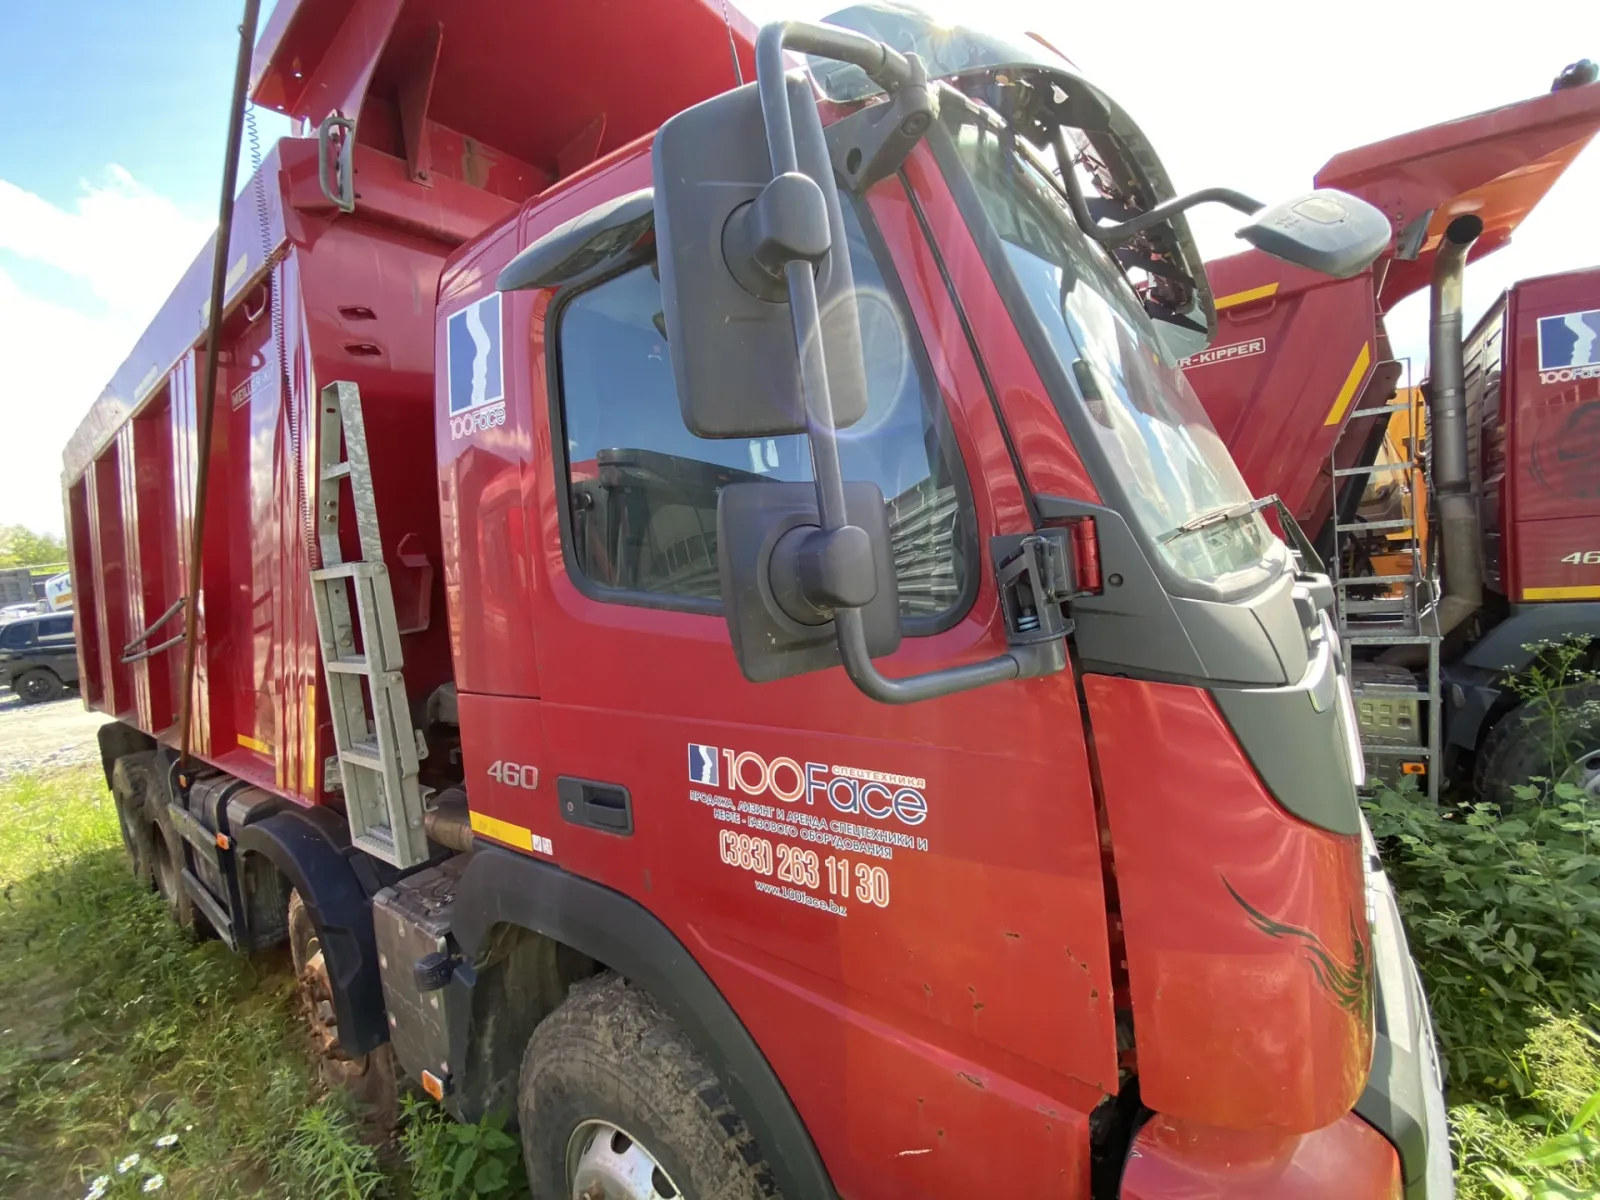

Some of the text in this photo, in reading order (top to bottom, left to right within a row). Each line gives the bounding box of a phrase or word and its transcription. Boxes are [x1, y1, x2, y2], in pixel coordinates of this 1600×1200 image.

[450, 405, 506, 440] 100Face
[487, 760, 539, 790] 460
[723, 748, 928, 825] 100Face
[832, 765, 926, 789] СПЕЦТЕХНИКА
[738, 801, 775, 817] ЛИЗИНГ
[776, 808, 784, 820] И
[786, 811, 828, 830] АРЕНДА
[830, 820, 914, 848] СПЕЦТЕХНИКИ
[917, 837, 928, 851] И
[748, 816, 798, 837] ГАЗОВОГО
[800, 828, 892, 859] ОБОРУДОВАНИЯ
[719, 829, 889, 907] (383) 263 11 30
[755, 880, 847, 916] www.100face.biz
